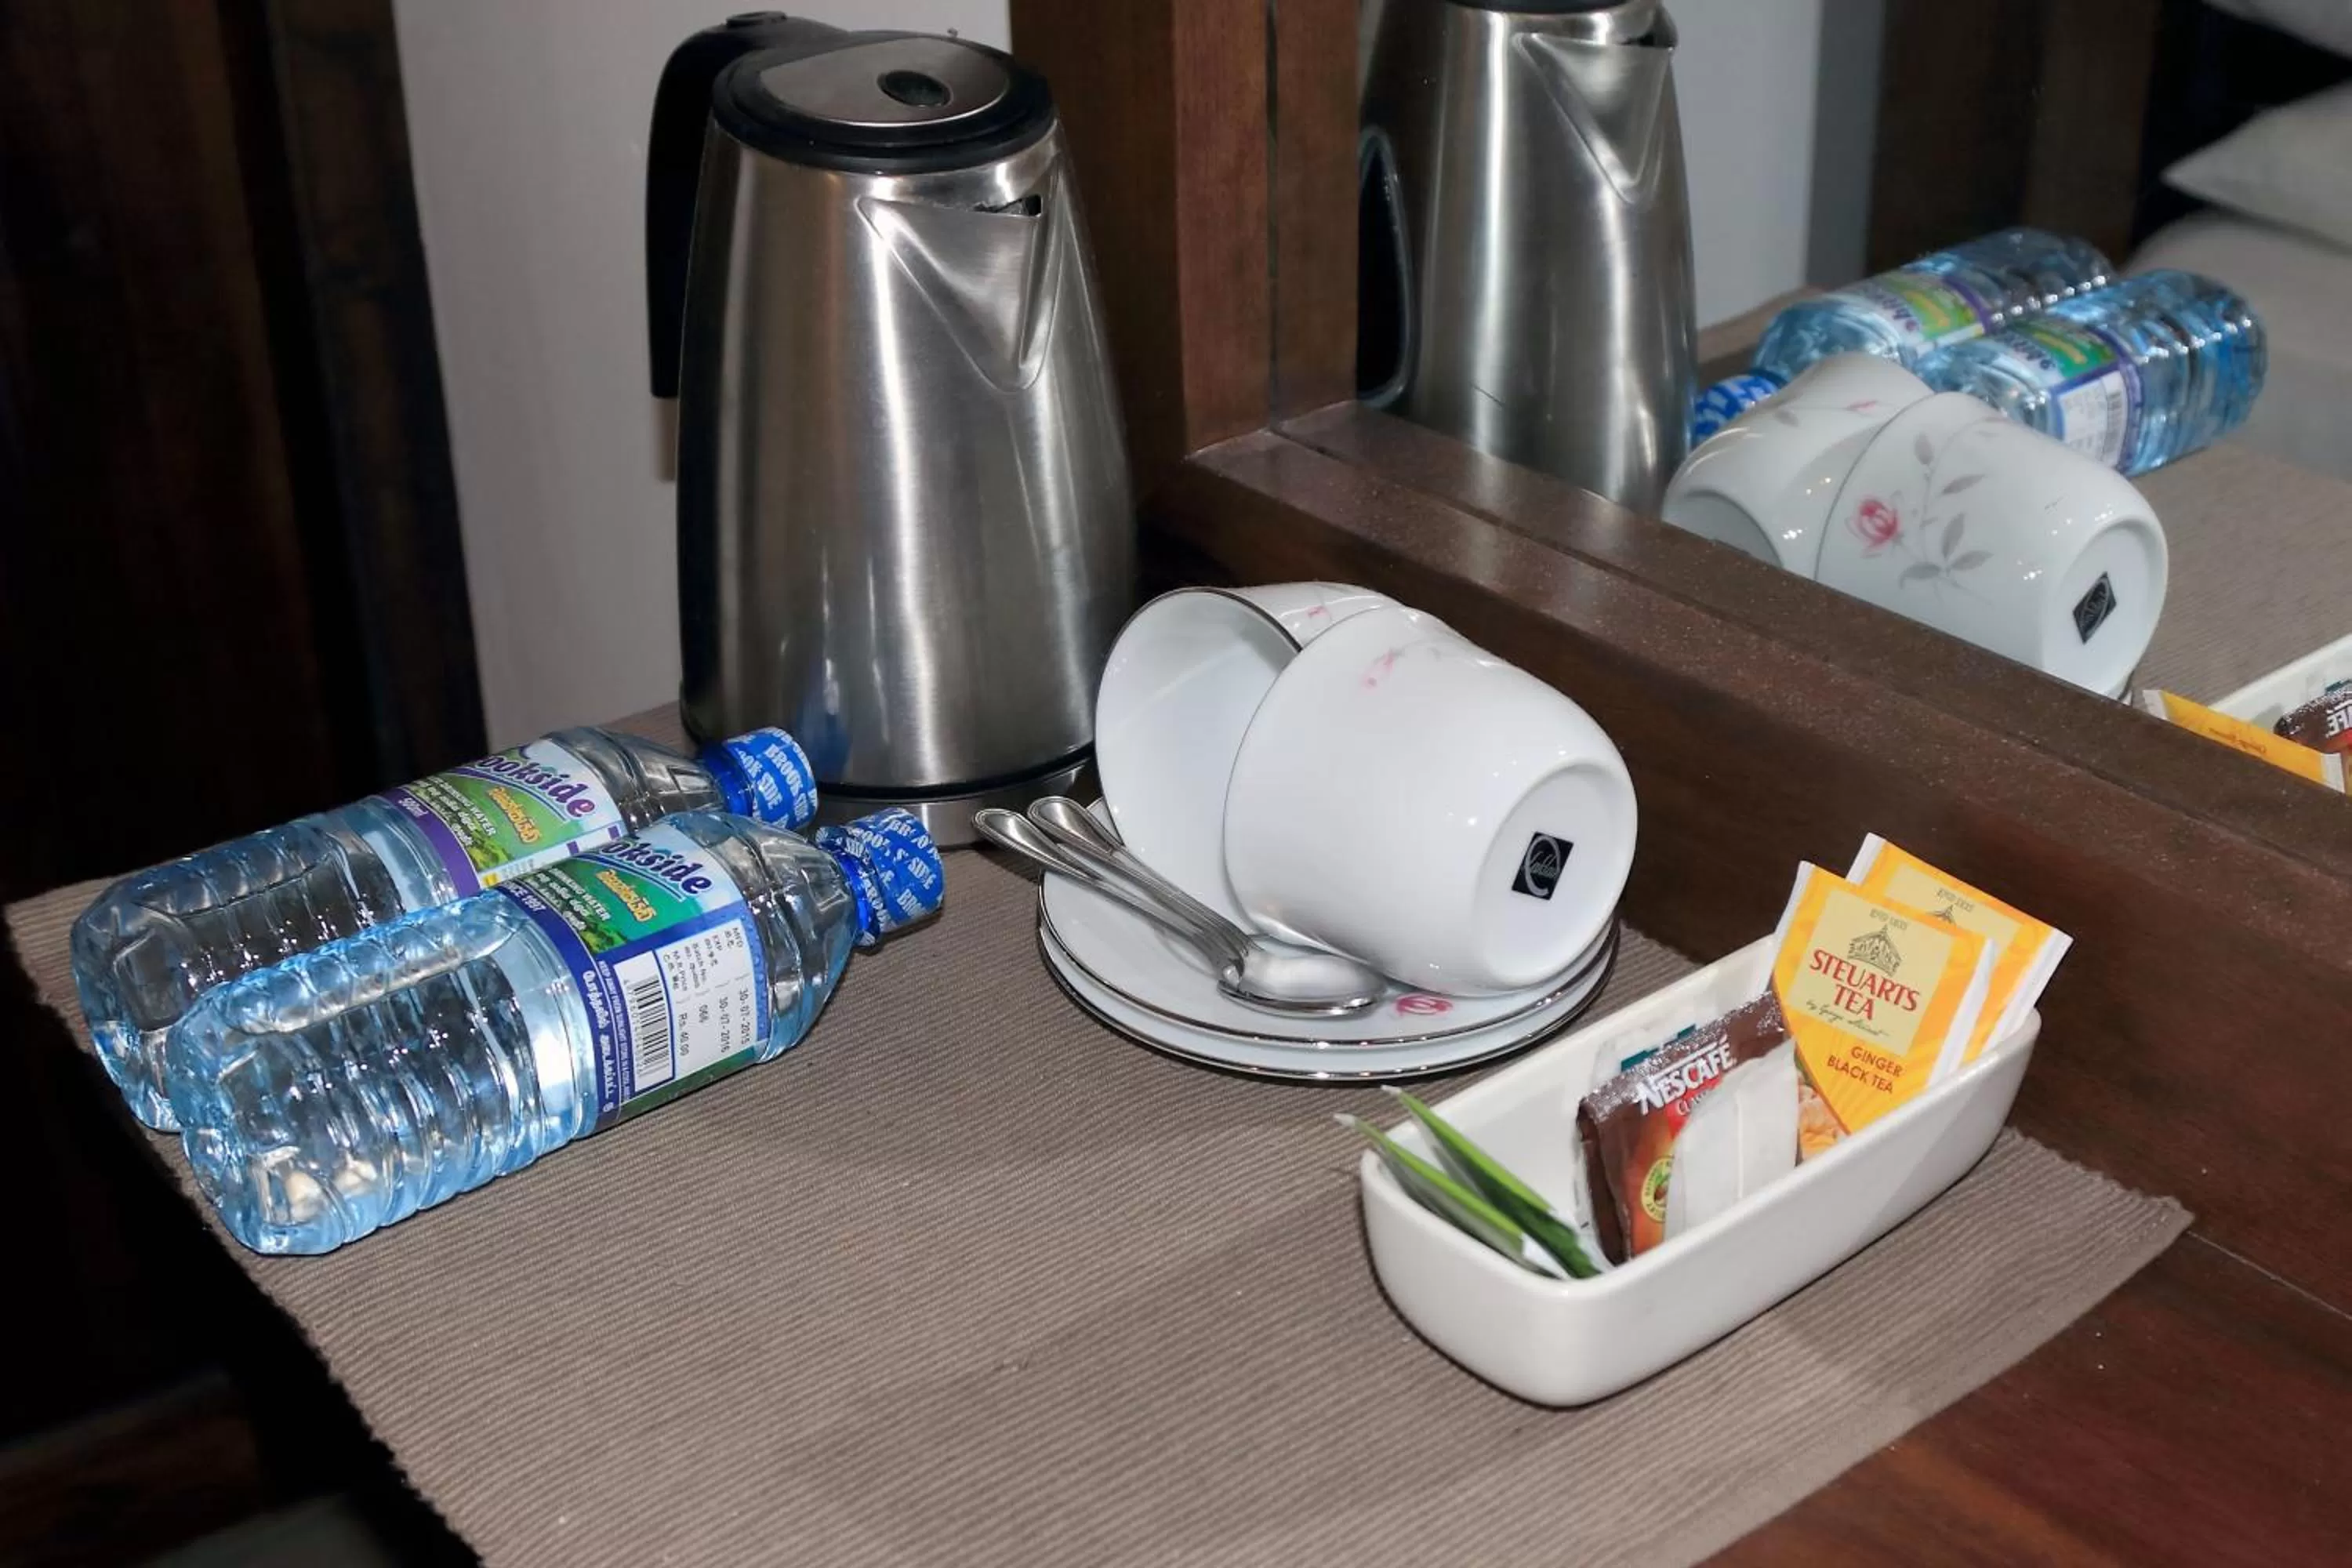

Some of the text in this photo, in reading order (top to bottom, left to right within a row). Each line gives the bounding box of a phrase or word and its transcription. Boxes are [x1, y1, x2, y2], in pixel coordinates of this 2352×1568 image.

[476, 754, 596, 818] ookside
[764, 743, 803, 797] BROOK
[470, 805, 497, 837] WATER
[601, 840, 712, 895] okside
[582, 892, 612, 923] WATER
[1809, 949, 1920, 1012] STEUARTS
[1834, 983, 1875, 1020] TEA
[1636, 1034, 1731, 1116] NESCAFÉ
[1827, 1055, 1894, 1094] BLACK TEA
[1850, 1045, 1903, 1077] GINGER
